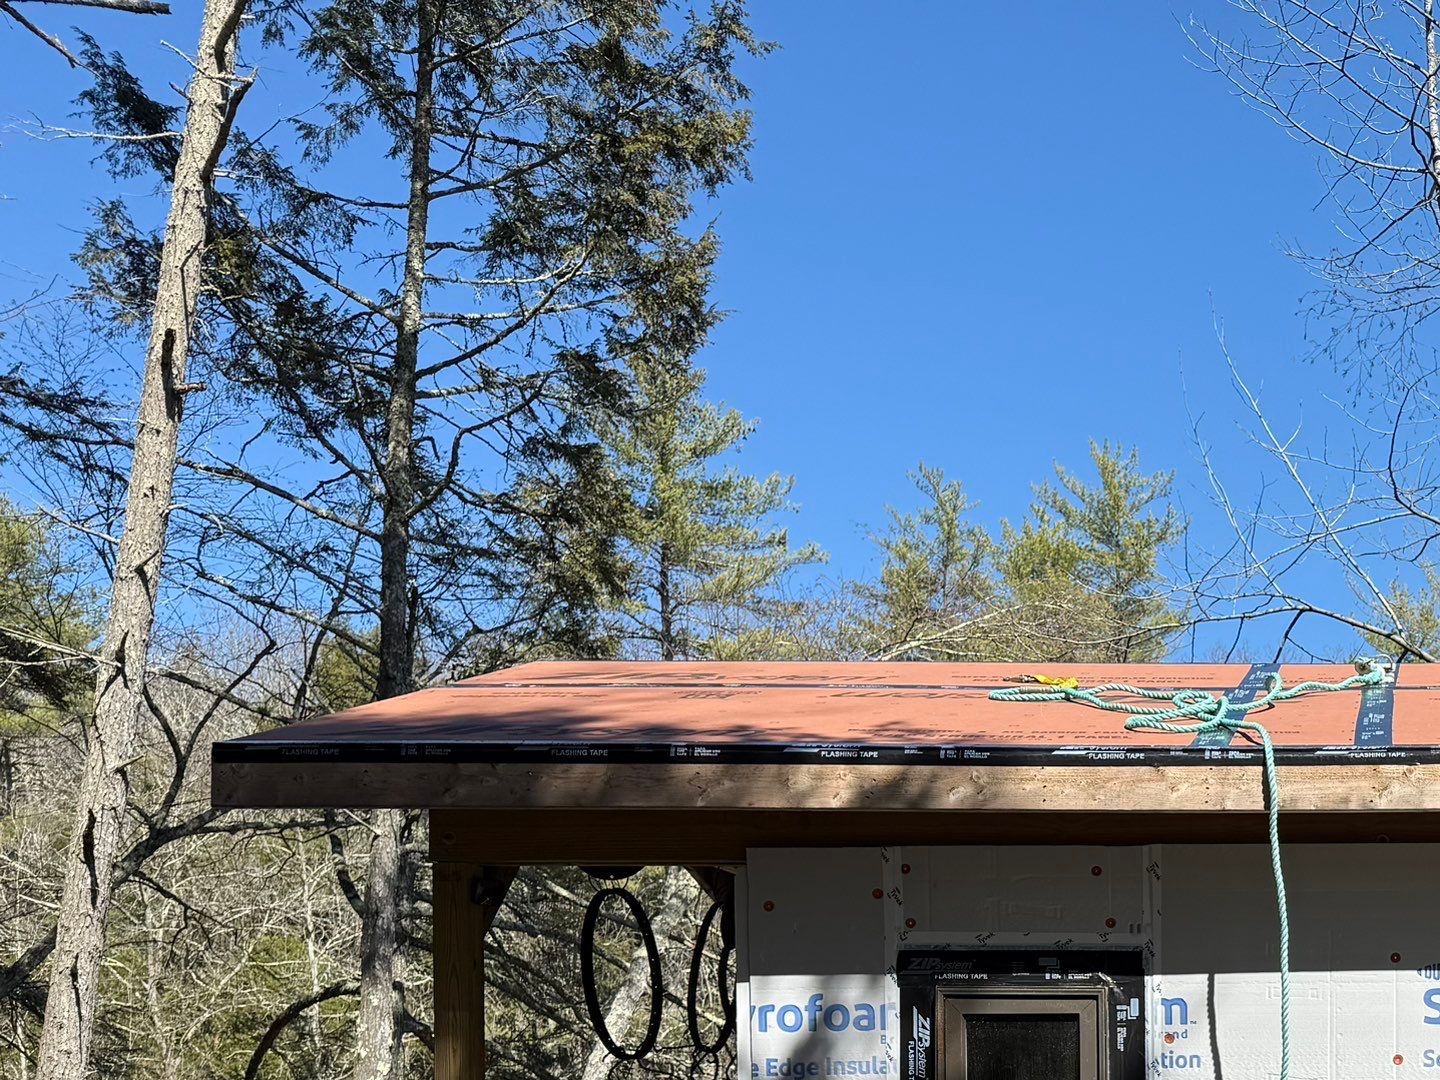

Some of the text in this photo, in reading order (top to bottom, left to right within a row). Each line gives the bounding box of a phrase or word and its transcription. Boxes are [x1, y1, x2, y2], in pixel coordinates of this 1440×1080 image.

[821, 750, 878, 758] FLASHING TAPE
[1088, 752, 1145, 760] FLASHING TAPE
[908, 957, 937, 970] ZIP
[751, 993, 890, 1033] rofoa
[919, 1013, 930, 1048] ZIP
[765, 1058, 819, 1080] Edge
